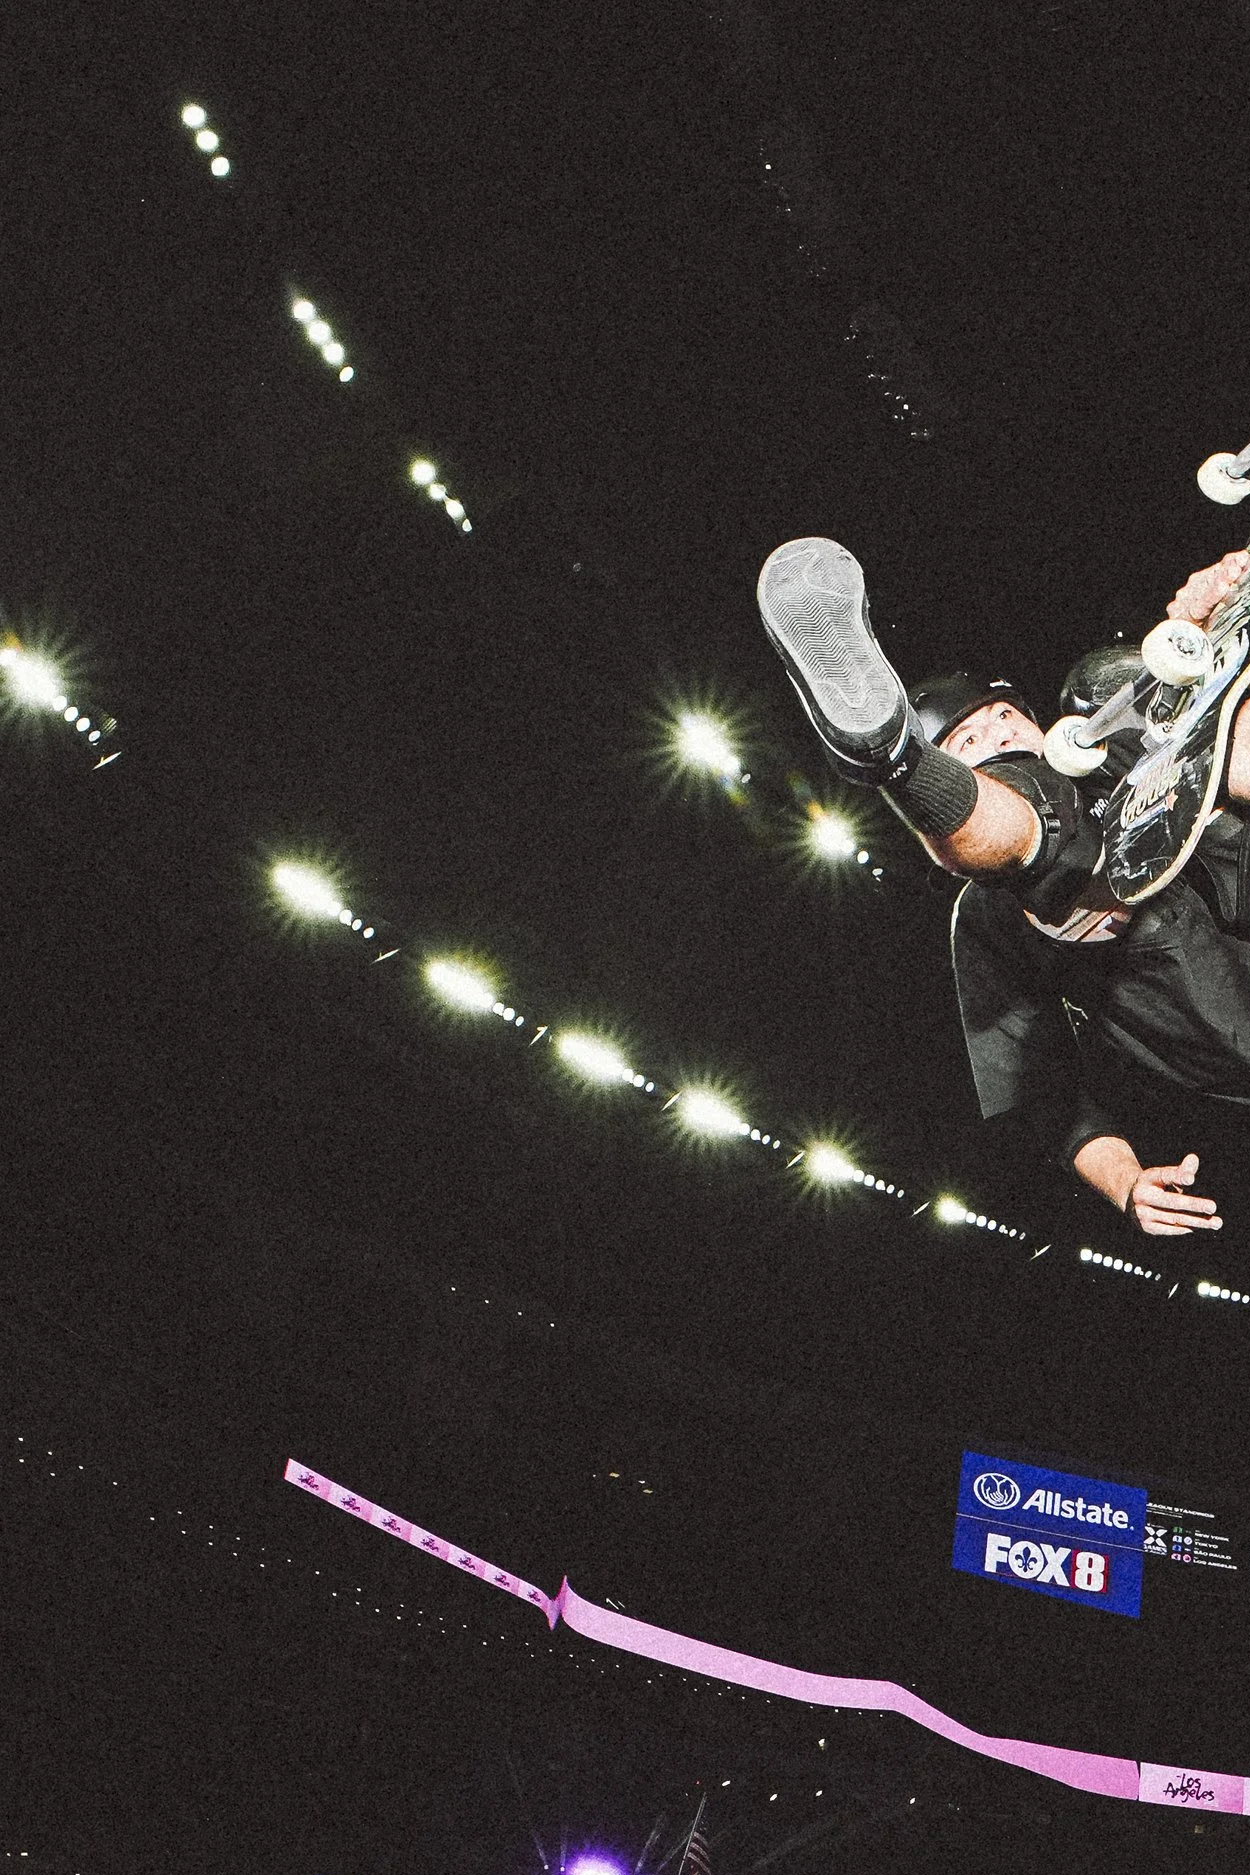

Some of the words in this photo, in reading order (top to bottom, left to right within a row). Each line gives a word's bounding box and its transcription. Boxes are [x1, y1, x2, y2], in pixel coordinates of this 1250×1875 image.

[1022, 1489, 1129, 1529] Allstate
[984, 1532, 1072, 1587] FOX
[1074, 1551, 1106, 1593] 8
